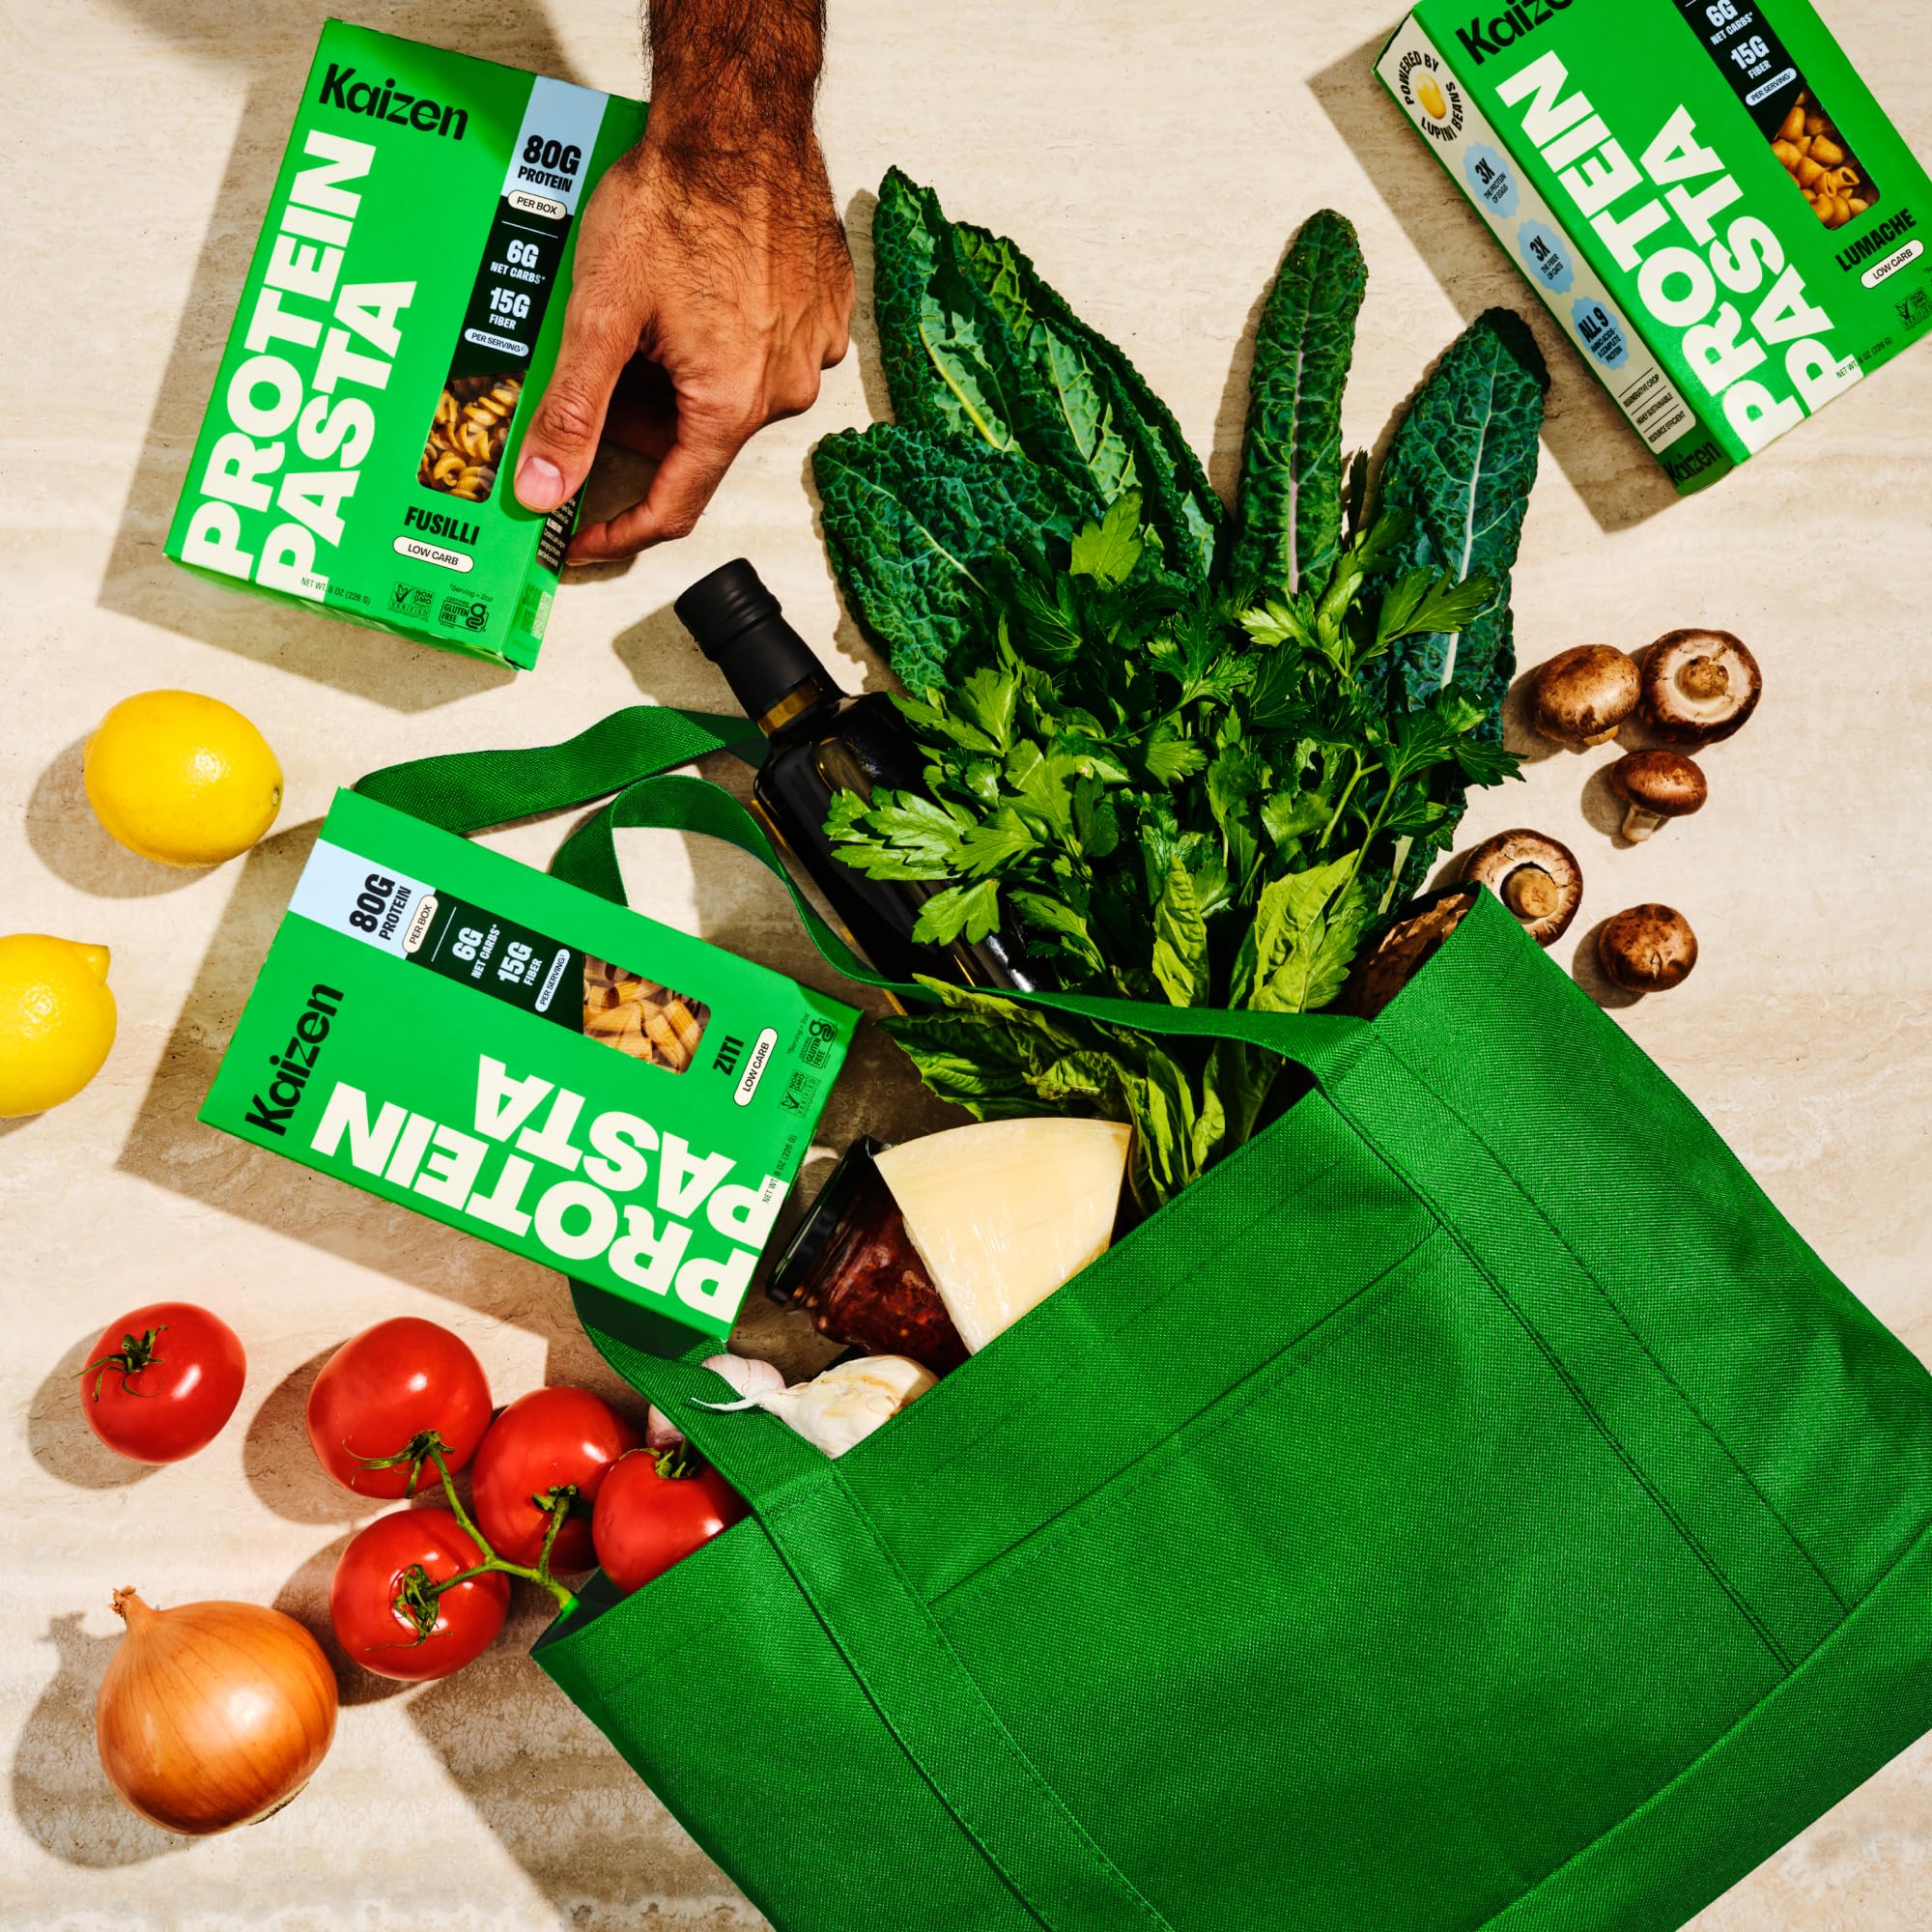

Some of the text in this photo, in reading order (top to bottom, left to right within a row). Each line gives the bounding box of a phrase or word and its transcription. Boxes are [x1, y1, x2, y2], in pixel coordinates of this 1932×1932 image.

[1705, 0, 1738, 27] 6G
[1710, 29, 1727, 45] NET
[1731, 35, 1770, 70] 15G
[1399, 50, 1439, 105] POWERED BY
[1747, 60, 1772, 79] FIBER
[319, 63, 469, 141] Kaizen
[1750, 89, 1765, 101] PER
[1421, 81, 1463, 142] LUPINI BEANS
[523, 134, 582, 176] 80G
[518, 165, 573, 192] PROTEIN
[1475, 156, 1495, 185] 3X
[1490, 172, 1506, 193] PROTEIN
[517, 196, 557, 214] PER BOX
[506, 240, 539, 269] 6G
[1494, 49, 1805, 455] PROTEIN
[1529, 234, 1550, 262] 3X
[1834, 208, 1917, 272] LUMACHE
[490, 261, 509, 275] NET
[1552, 262, 1564, 275] OATS
[1639, 103, 1864, 417] PASTA
[1872, 248, 1914, 279] LOW CARB
[490, 287, 530, 319] 15G
[1909, 289, 1923, 301] NON
[489, 313, 517, 330] FIBER
[1577, 306, 1609, 343] ALL 9
[471, 332, 487, 343] PER
[181, 129, 377, 582] PROTEIN
[1836, 366, 1848, 378] NET
[1862, 351, 1872, 360] OZ
[1623, 374, 1660, 408] REGENERATIVE CROP
[1647, 392, 1673, 416] SUSTAINABLE
[1648, 411, 1686, 443] RESOURCE EFFICIENT
[255, 281, 417, 604] PASTA
[1662, 440, 1721, 487] Kaizen
[404, 505, 480, 546] FUSILLI
[408, 544, 459, 566] LOW CARB
[301, 577, 315, 586] NET
[334, 587, 345, 597] OZ
[345, 590, 361, 602] (226
[413, 595, 432, 605] GMO
[415, 589, 433, 599] NON
[391, 600, 428, 616] VERIFIED
[441, 611, 457, 623] FREE
[443, 603, 469, 617] GLUTEN
[349, 873, 396, 933] 80G
[378, 886, 412, 941] PROTEIN
[410, 903, 432, 945] PER BOX
[452, 927, 484, 961] 6G
[470, 959, 486, 980] NET
[497, 941, 533, 983] 15G
[523, 958, 543, 986] FIBER
[540, 989, 552, 1005] PER
[244, 983, 344, 1137] Kaizen
[712, 1035, 745, 1076] ZITI
[806, 1037, 821, 1063] GLUTEN
[813, 1049, 826, 1066] FREE
[742, 1041, 770, 1092] LOW CARB
[788, 1071, 799, 1090] NON
[794, 1073, 805, 1092] GMO
[473, 1053, 791, 1251] PASTA
[762, 1189, 773, 1204] NET
[777, 1160, 786, 1171] OZ
[310, 1081, 759, 1323] PROTEIN
